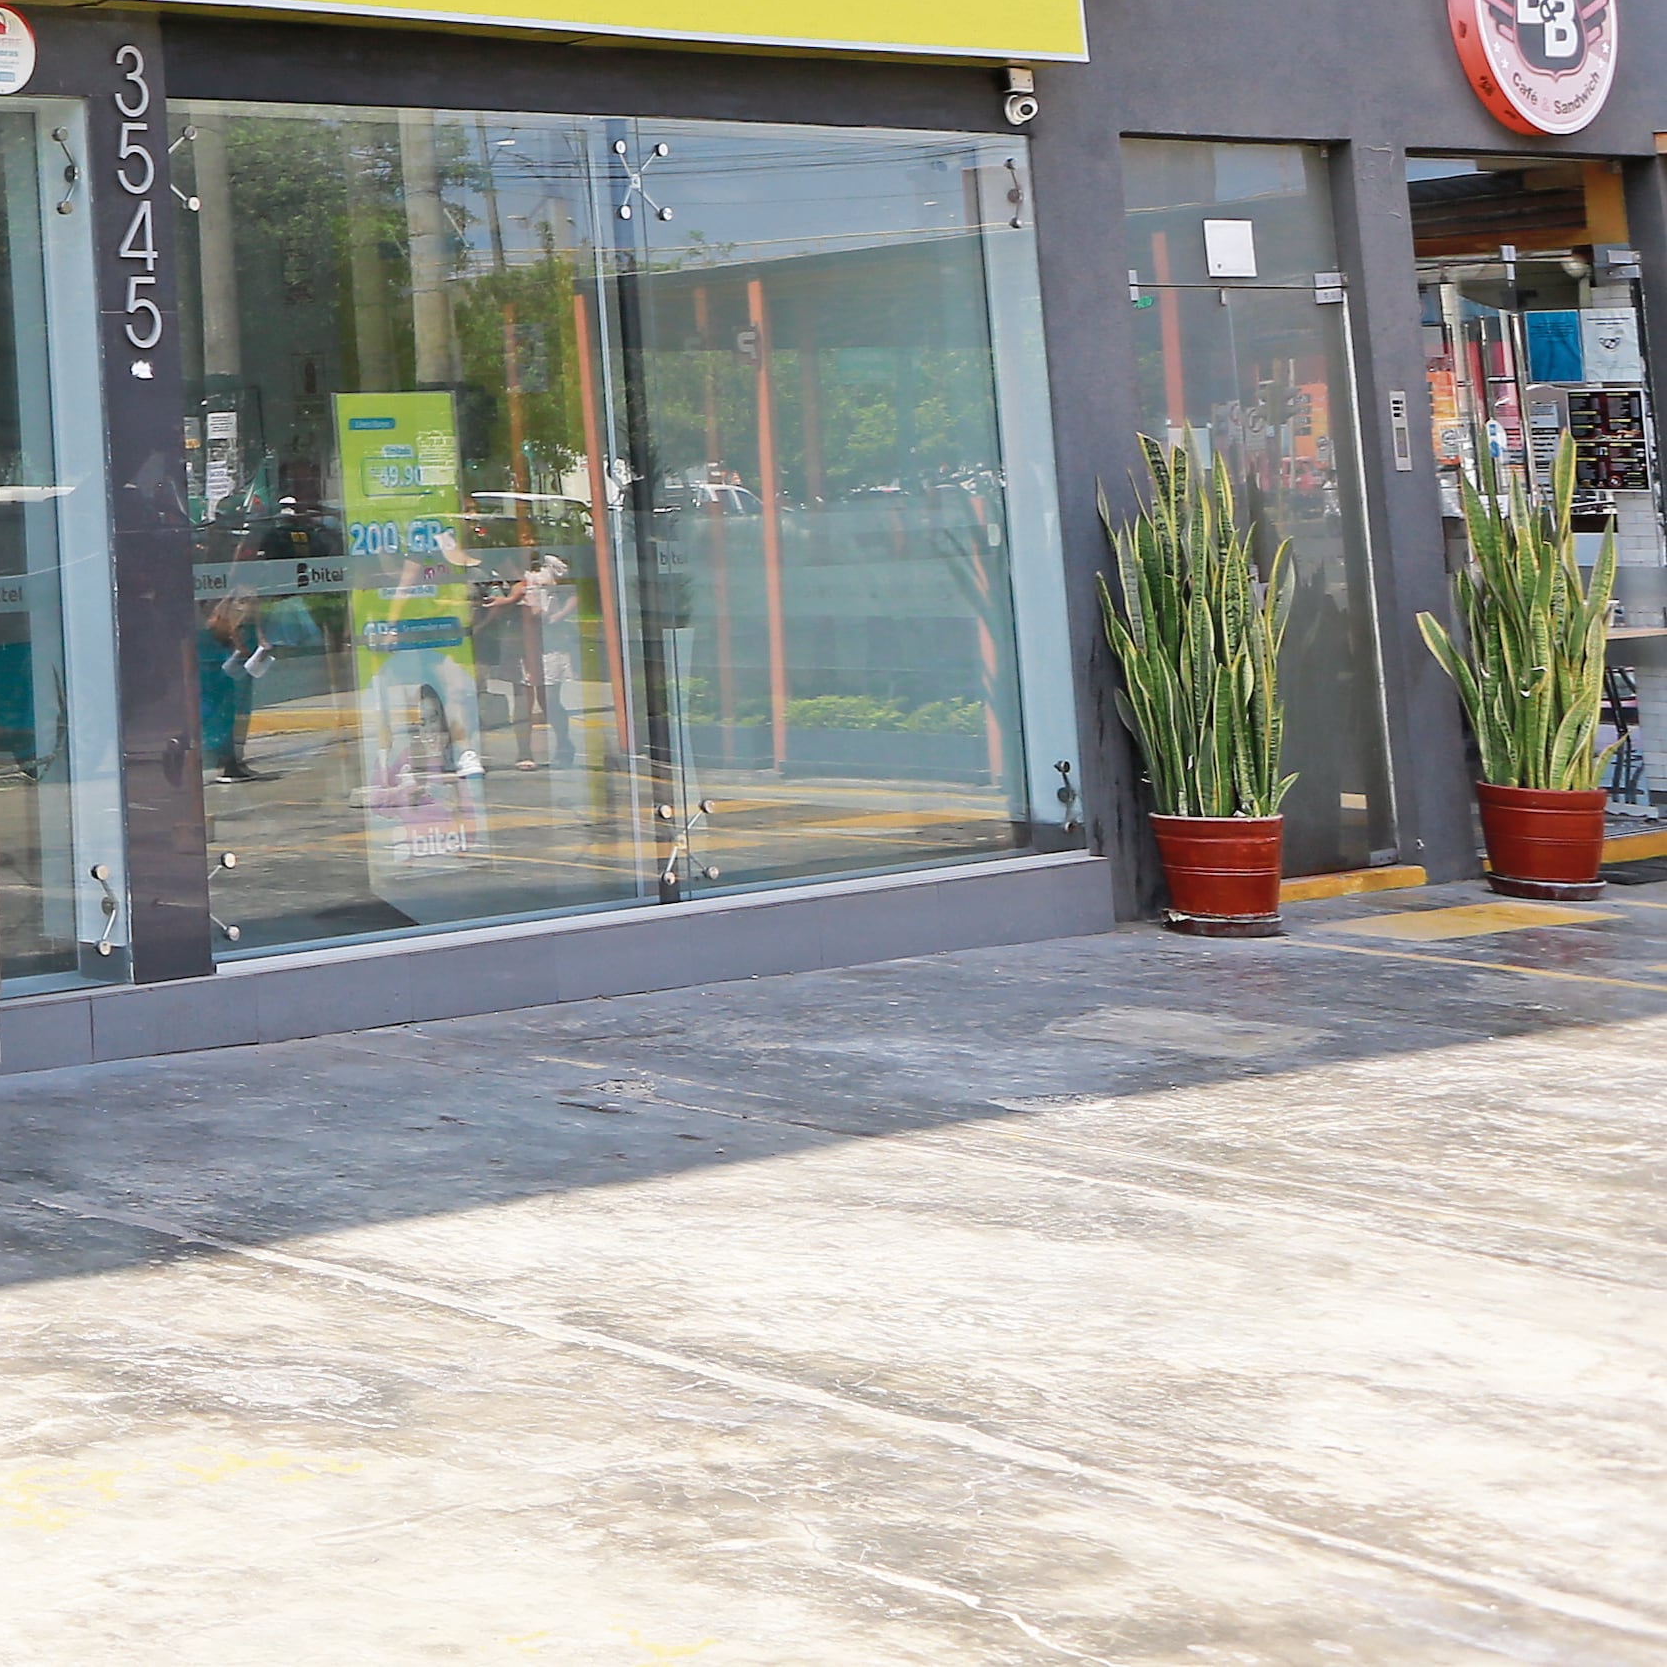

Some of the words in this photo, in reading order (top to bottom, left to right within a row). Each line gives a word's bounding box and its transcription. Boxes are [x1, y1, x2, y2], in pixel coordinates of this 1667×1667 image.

[1512, 71, 1539, 106] Café
[1554, 70, 1601, 116] Sandwich
[114, 44, 163, 350] 3545
[349, 520, 400, 556] 200
[310, 566, 345, 584] bitel
